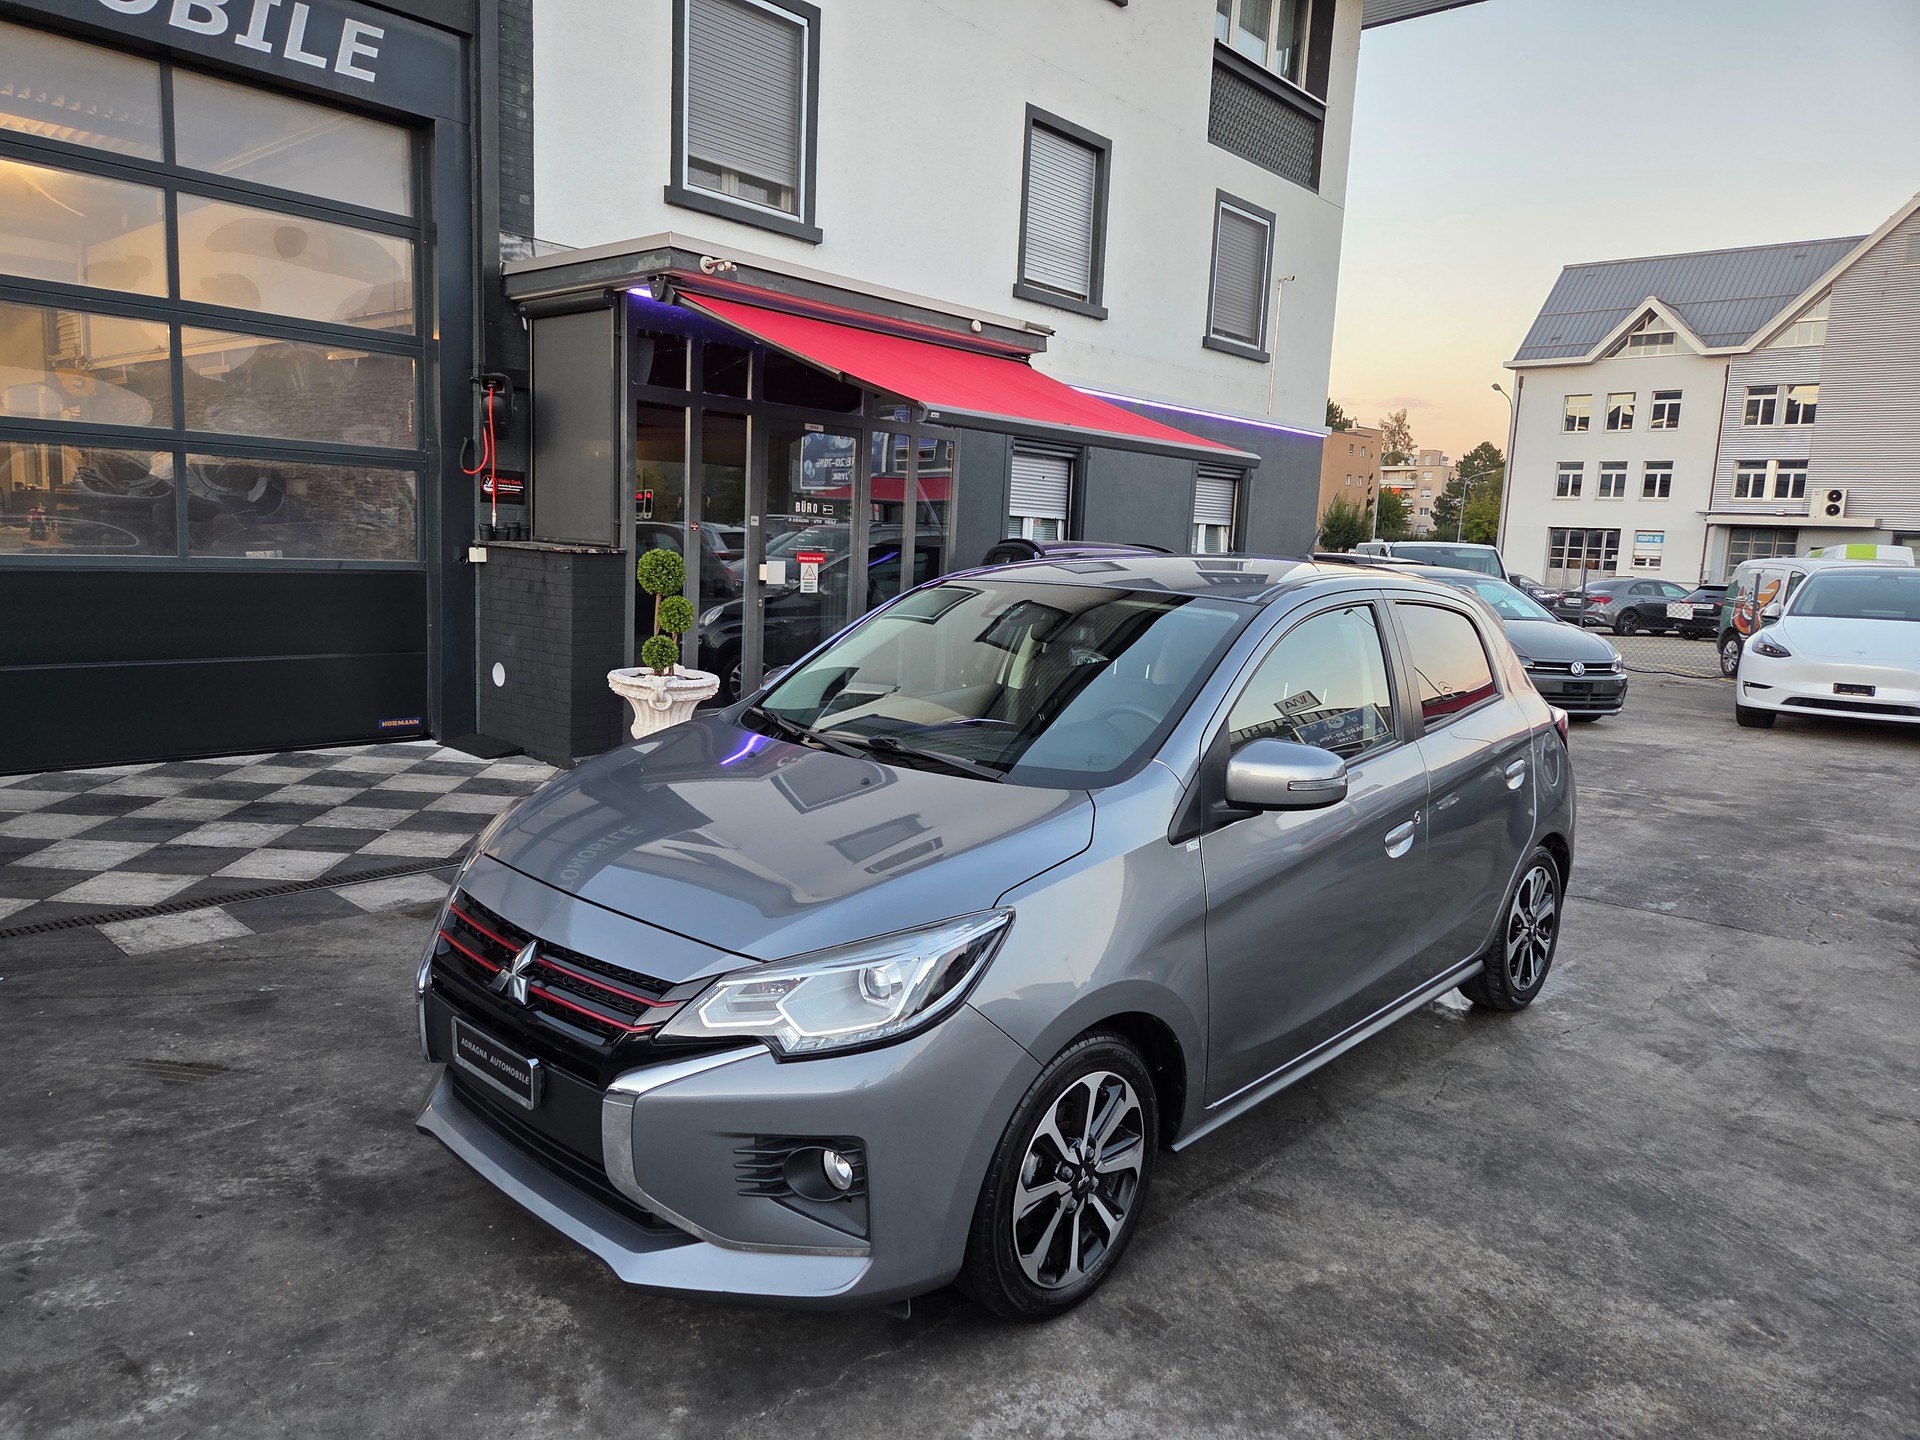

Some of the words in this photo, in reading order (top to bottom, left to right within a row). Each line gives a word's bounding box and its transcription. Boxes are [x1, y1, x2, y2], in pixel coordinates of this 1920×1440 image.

[795, 500, 818, 514] BÜRO
[460, 1037, 488, 1060] ADRAGNA
[489, 1055, 531, 1085] AUTOMOBILE
